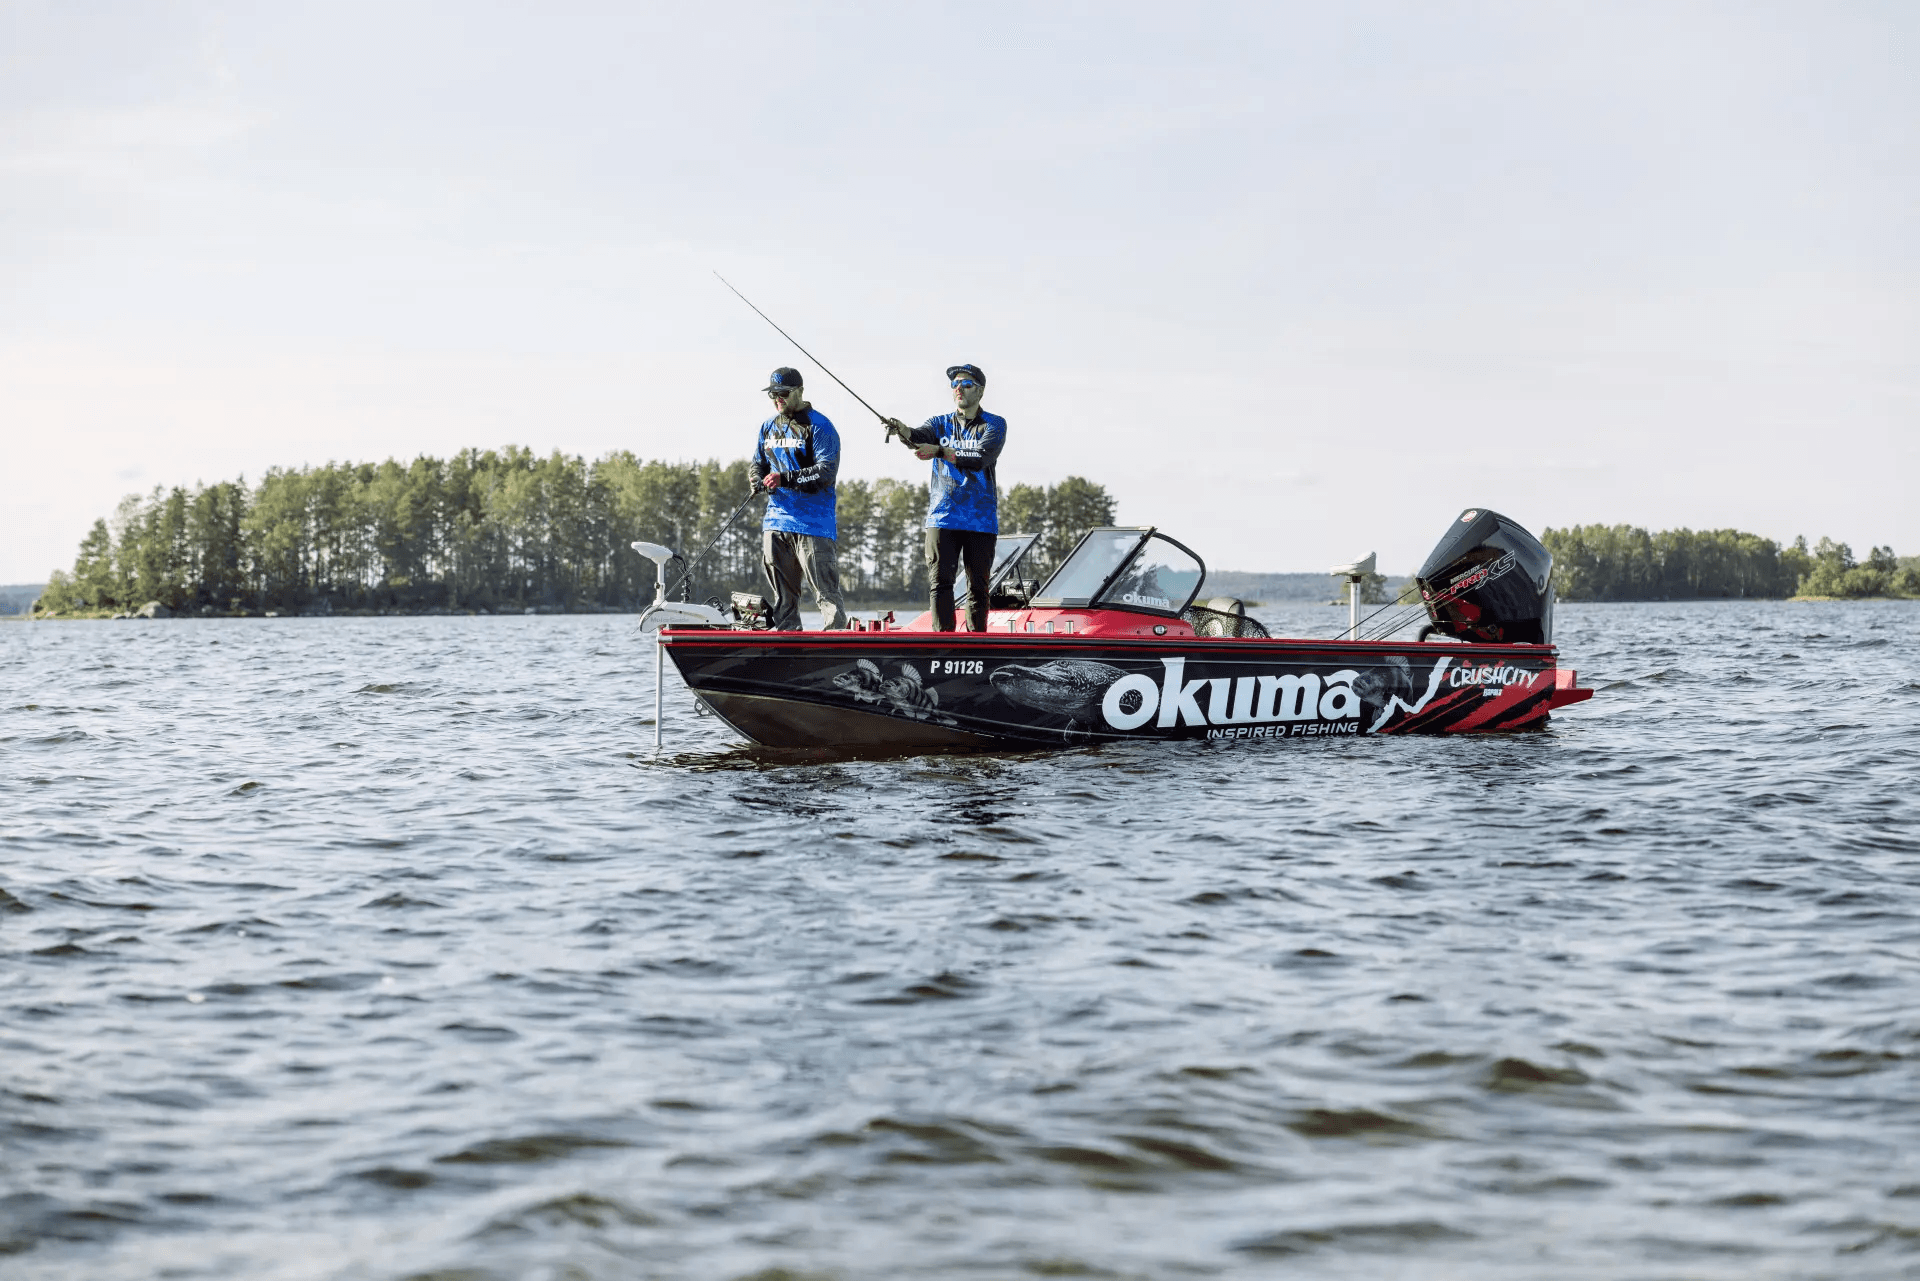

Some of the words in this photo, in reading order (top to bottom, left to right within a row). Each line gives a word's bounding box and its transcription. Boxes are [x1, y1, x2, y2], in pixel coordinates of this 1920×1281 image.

[1122, 592, 1170, 608] okuma
[930, 661, 940, 674] P
[944, 661, 984, 674] 91126
[1102, 656, 1361, 730] okuma
[1206, 725, 1286, 739] INSPIRED
[1291, 721, 1359, 735] FISHING
